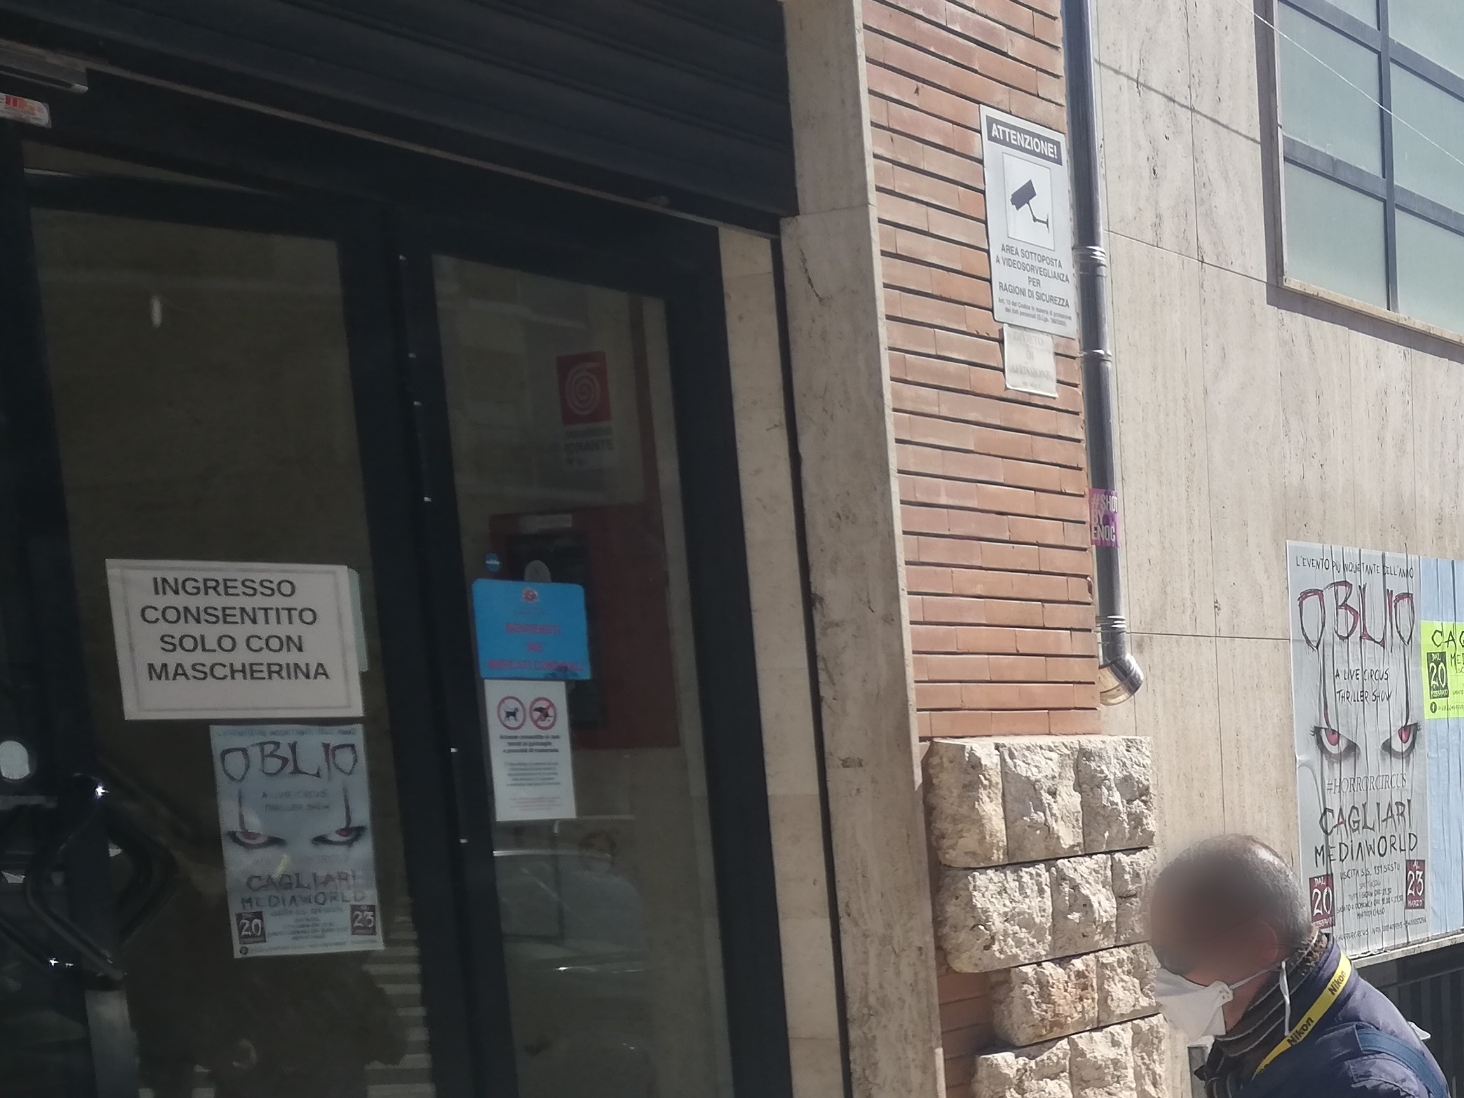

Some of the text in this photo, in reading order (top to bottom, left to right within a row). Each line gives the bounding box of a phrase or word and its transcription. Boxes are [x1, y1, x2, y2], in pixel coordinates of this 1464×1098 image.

[992, 123, 1057, 159] ATTENZIONE!
[1001, 243, 1063, 269] AREA SOTTOPOSTA
[996, 254, 1070, 284] A VIDEOSORVEGLIANZA
[1027, 276, 1041, 288] PER
[998, 281, 1070, 308] RAGIONI DI SICUREZZA
[1296, 555, 1330, 571] L'EVENTO
[153, 577, 296, 597] INGRESSO
[140, 605, 317, 625] CONSENTITO
[159, 634, 304, 652] SOLO CON
[147, 662, 330, 681] MASCHERINA
[1335, 668, 1389, 681] A LIVE CIRCUS
[1429, 661, 1447, 688] 20
[1336, 688, 1393, 705] THRILLER SHOW
[220, 741, 358, 782] OBLIO
[1327, 773, 1406, 794] #HORRORCIRCUS
[1319, 799, 1412, 838] CAGLIARI
[246, 870, 356, 891] CAGLIARI
[1407, 871, 1424, 897] 23
[1312, 887, 1333, 916] 20
[239, 919, 262, 936] 20
[353, 911, 375, 928] 23
[1328, 971, 1346, 996] Nikon
[1286, 1016, 1314, 1046] Nikon
